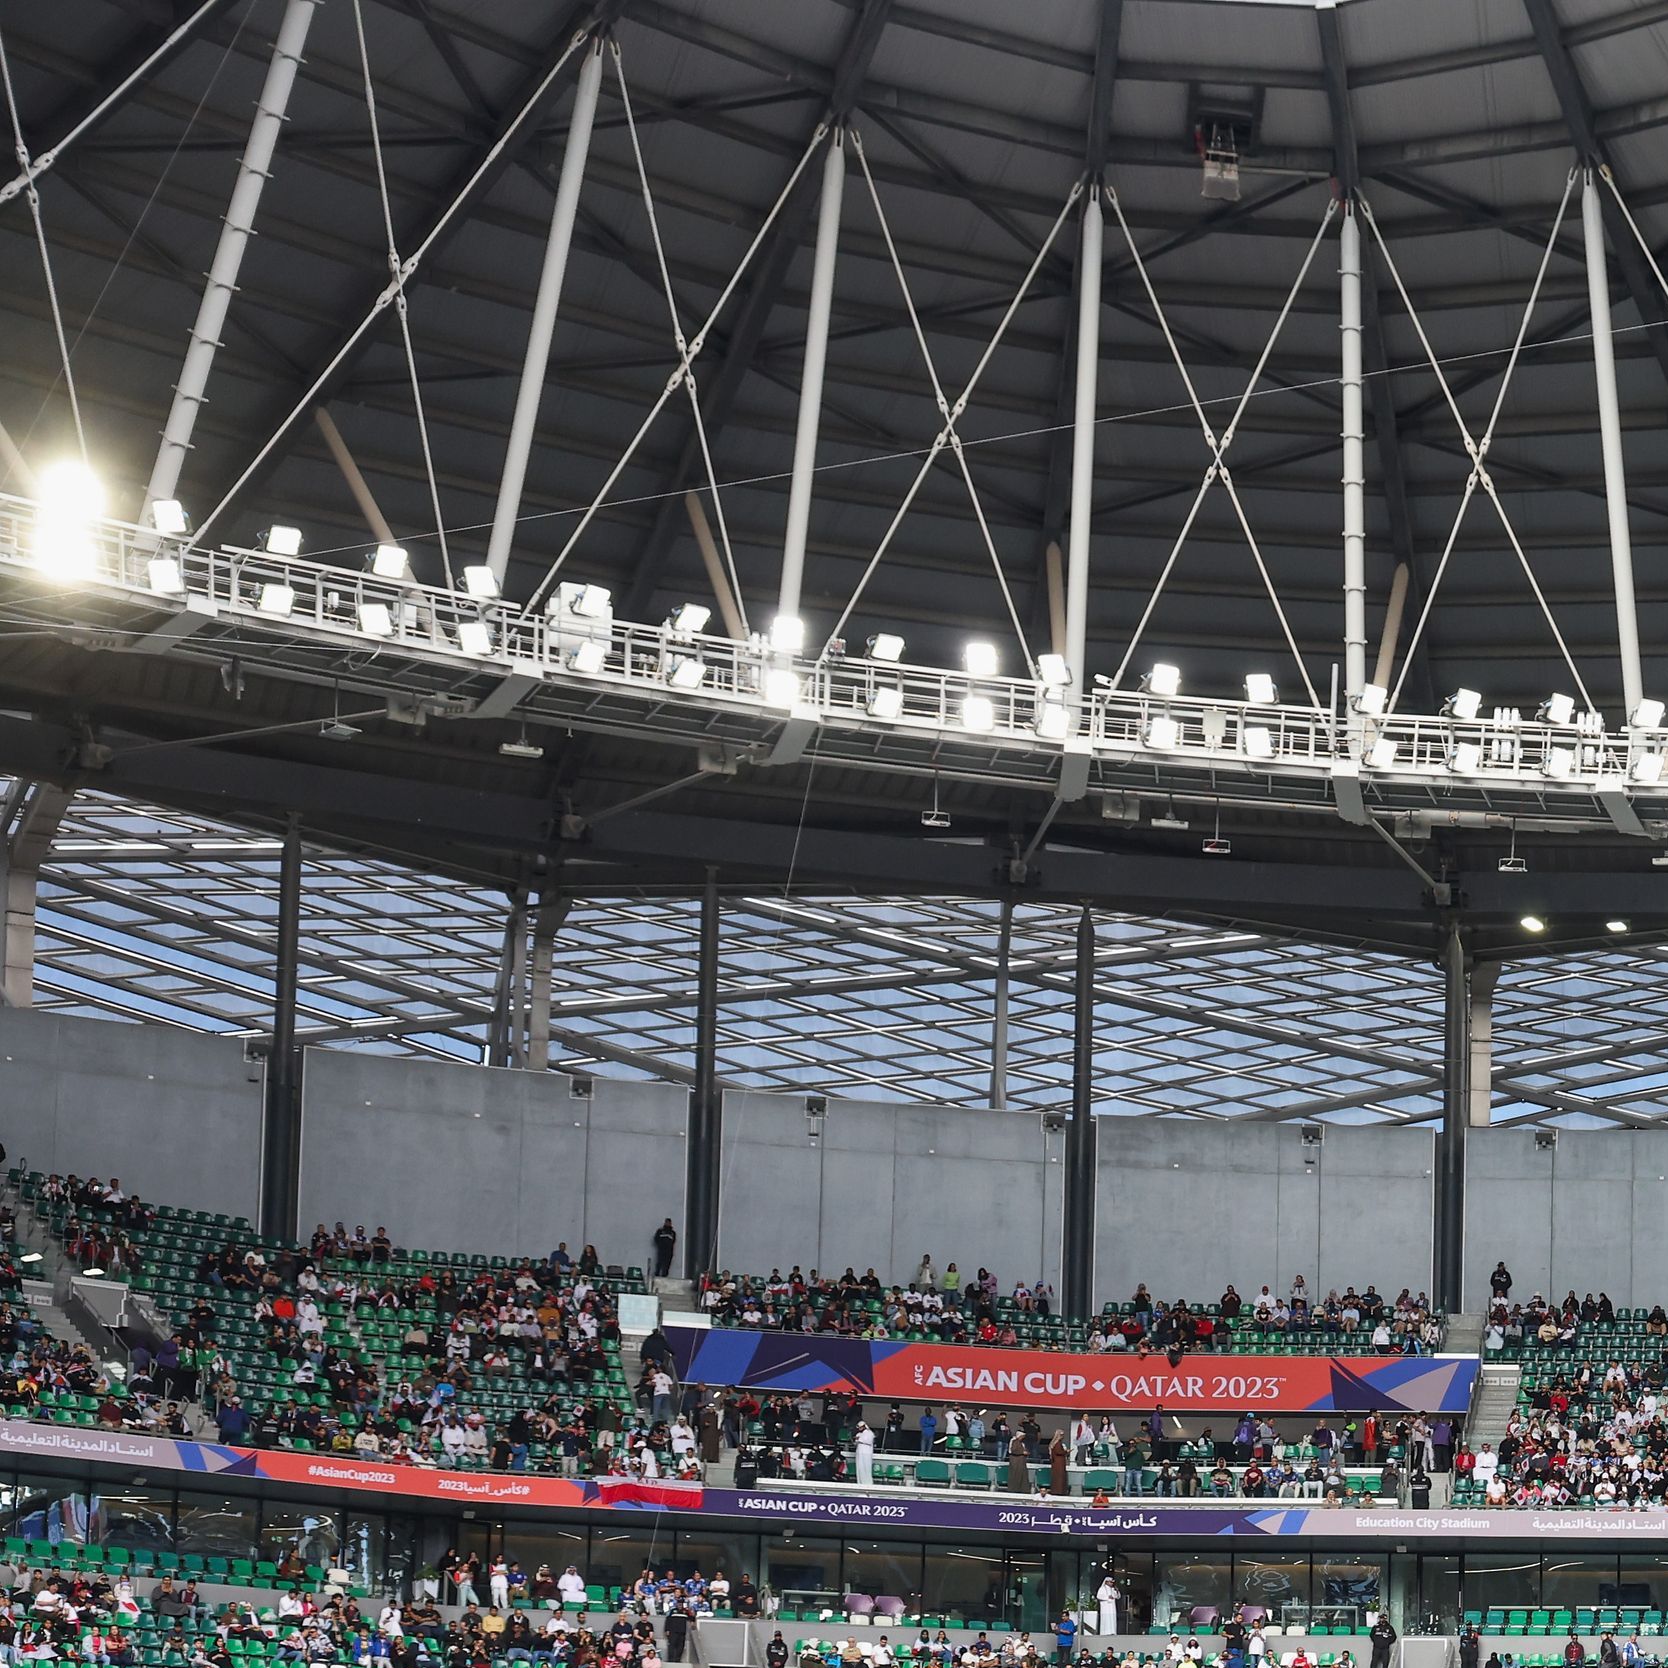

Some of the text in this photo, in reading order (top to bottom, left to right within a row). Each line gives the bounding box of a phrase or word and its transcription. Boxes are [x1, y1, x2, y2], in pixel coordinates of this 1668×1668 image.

[914, 1365, 924, 1386] AFC
[924, 1366, 1018, 1393] ASIAN
[1024, 1372, 1086, 1396] CUP
[1110, 1374, 1204, 1403] QATAR
[307, 1464, 396, 1485] #AsianCup2023
[744, 1497, 787, 1512] ASIAN
[788, 1500, 818, 1513] CUP
[827, 1502, 871, 1516] QATAR
[998, 1512, 1030, 1524] 2023
[1355, 1516, 1490, 1531] Education City Stadium
